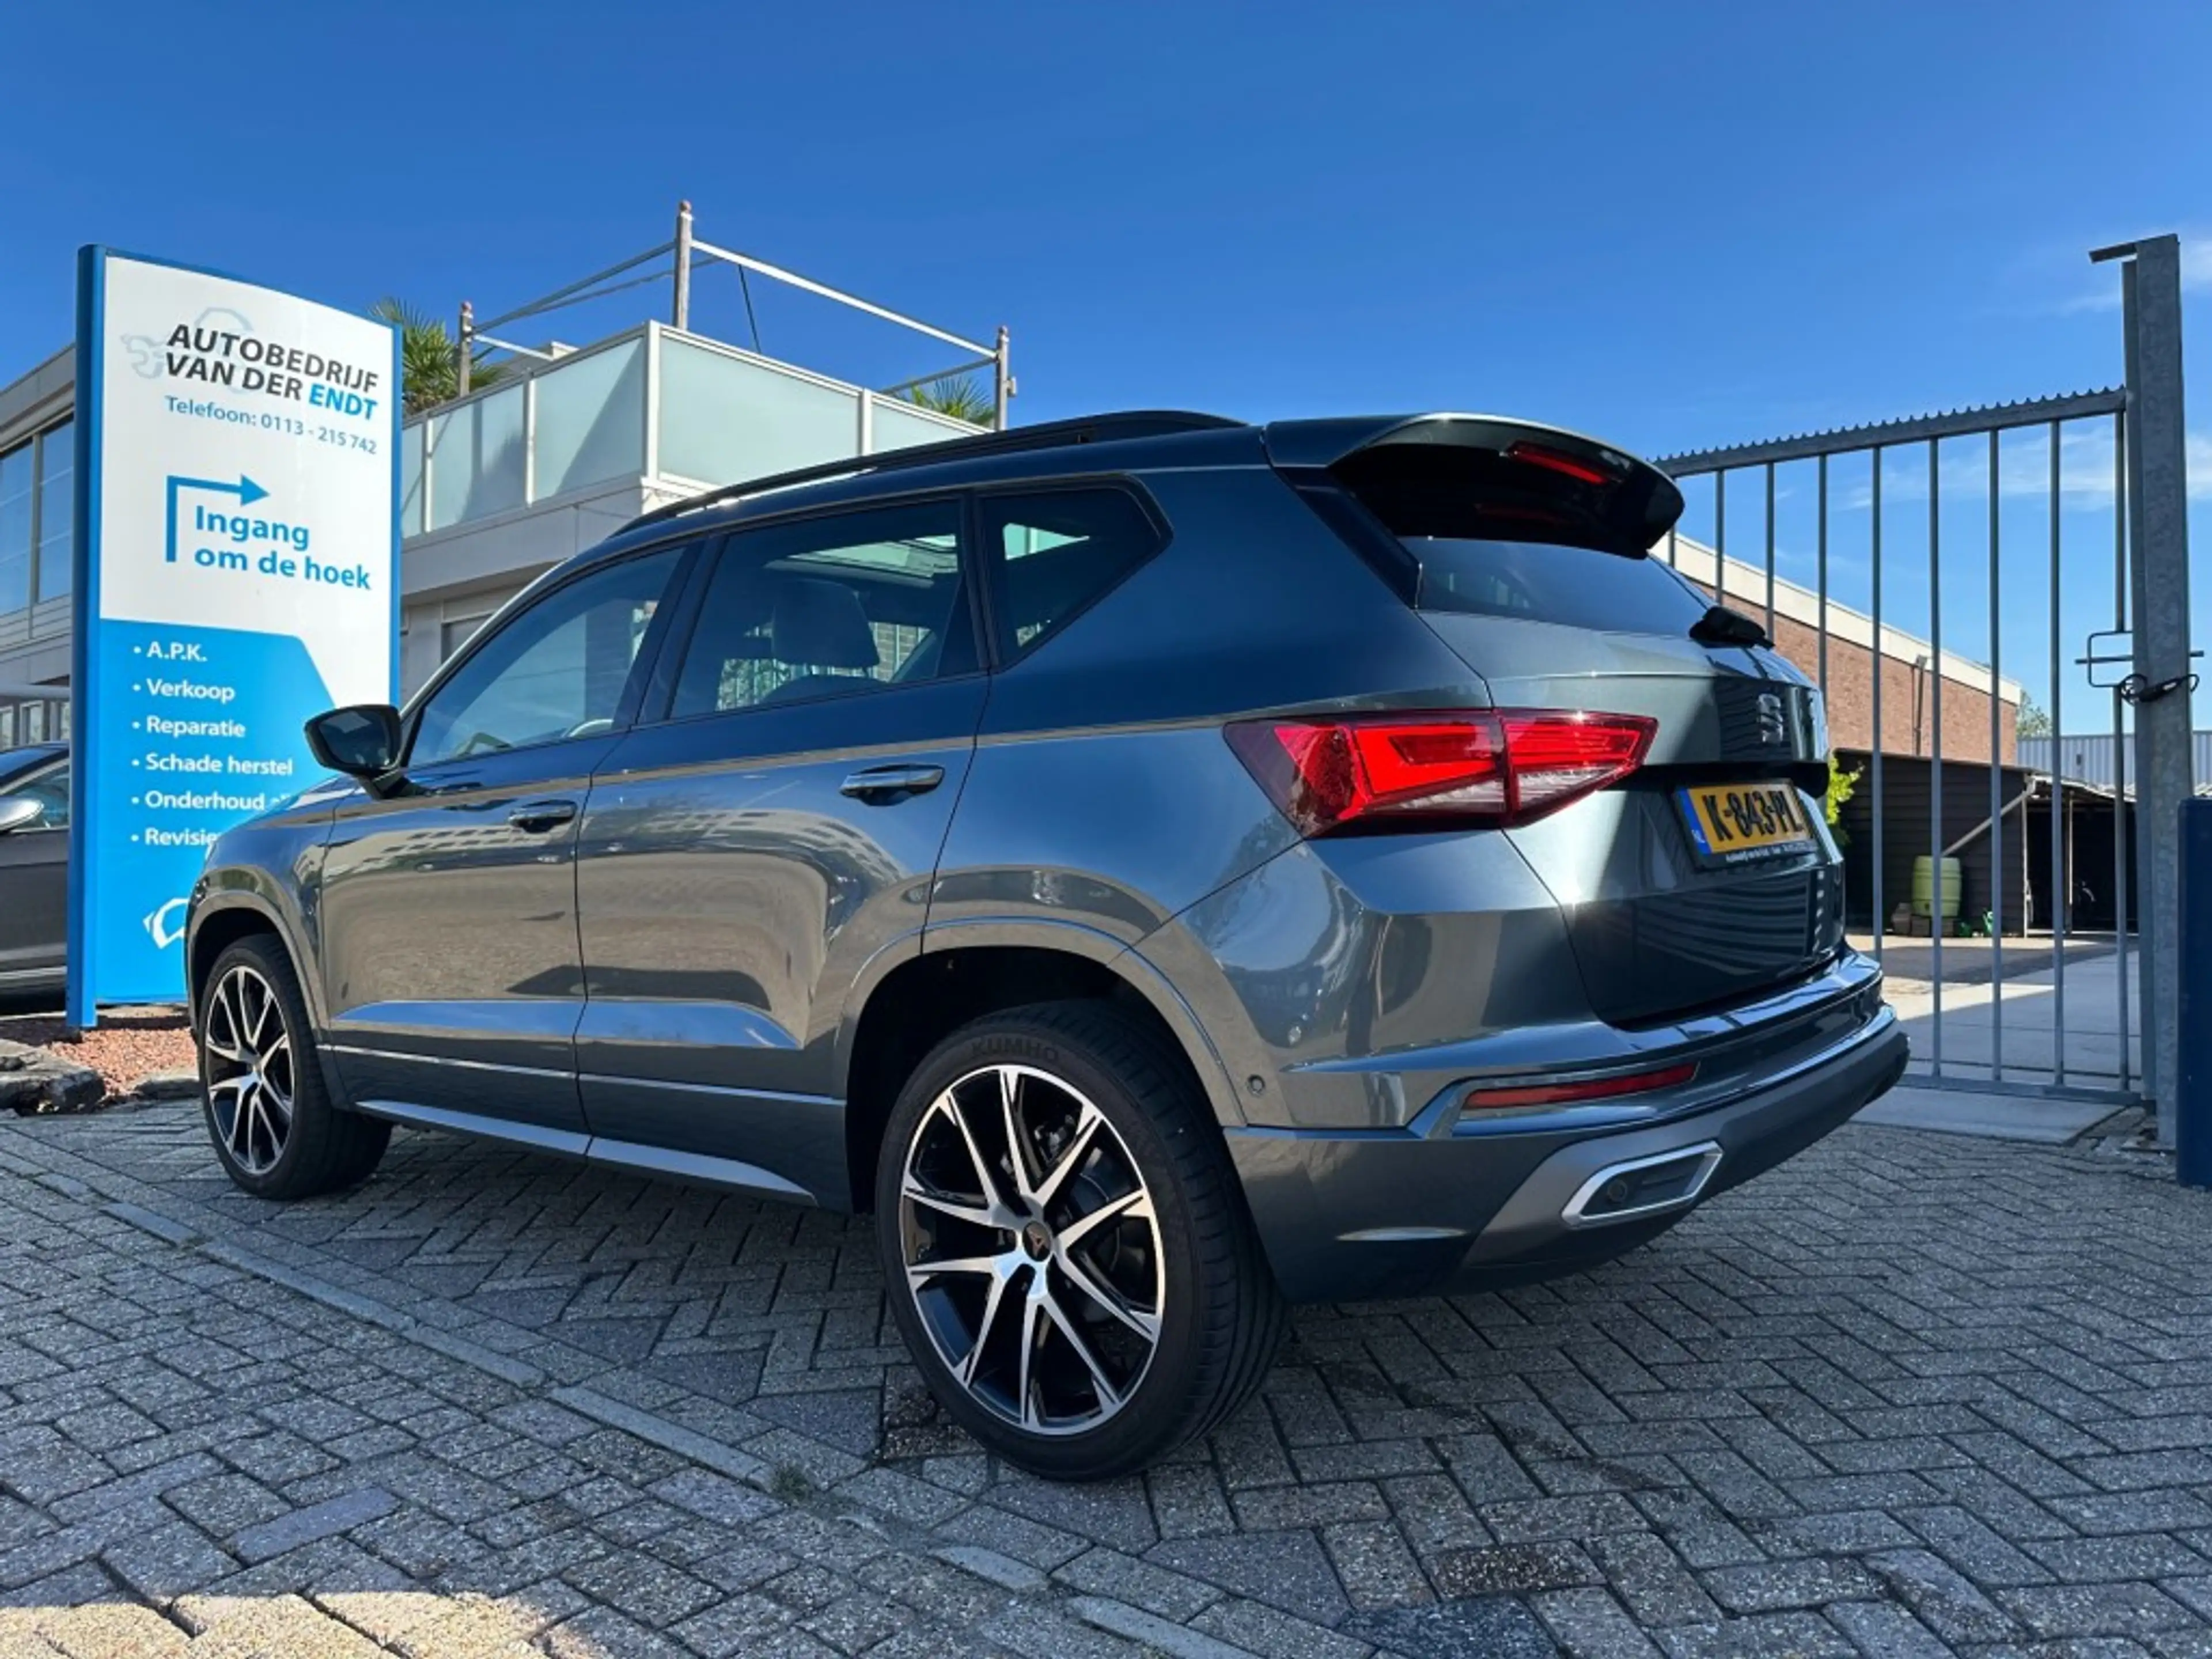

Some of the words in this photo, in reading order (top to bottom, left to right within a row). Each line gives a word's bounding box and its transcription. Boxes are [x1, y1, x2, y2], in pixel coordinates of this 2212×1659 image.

[166, 324, 378, 393] AUTOBEDRIJF
[166, 352, 236, 385] VAN
[241, 367, 303, 401] DER
[309, 383, 378, 421] ENDT
[164, 395, 256, 426] Telefoon:
[261, 414, 304, 435] 0113
[196, 505, 309, 551] Ingang
[194, 548, 248, 571] om
[257, 550, 296, 577] de
[305, 556, 372, 590] hoek
[147, 641, 207, 662] A.P.K.
[147, 679, 236, 703] Verkoop
[147, 715, 246, 738] Reparatie
[146, 752, 222, 774] Schade
[228, 755, 293, 777] herstel
[146, 790, 265, 812] Onderhoud
[1702, 790, 1804, 841] K-843-PL
